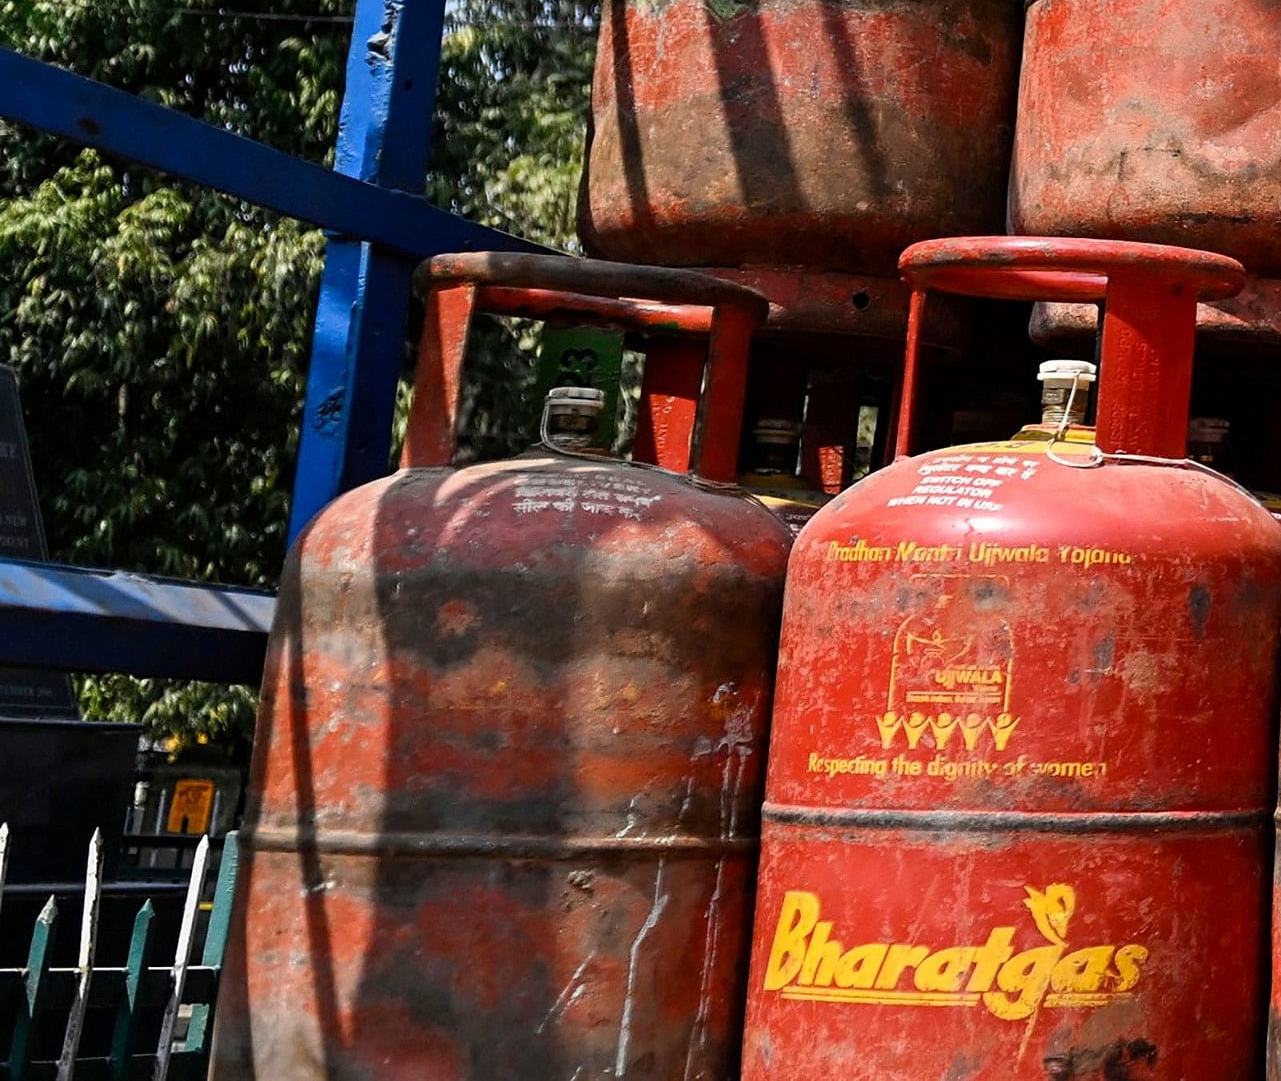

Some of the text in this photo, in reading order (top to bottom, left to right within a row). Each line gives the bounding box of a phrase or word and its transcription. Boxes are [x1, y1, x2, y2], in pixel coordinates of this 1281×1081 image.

[827, 540, 891, 563] Pradhan
[894, 540, 962, 564] Mantri
[968, 541, 1050, 568] Ujjwala
[809, 752, 887, 779] Respecting
[892, 754, 922, 776] the
[1003, 755, 1027, 777] of
[764, 890, 1149, 1021] Bharatgas
